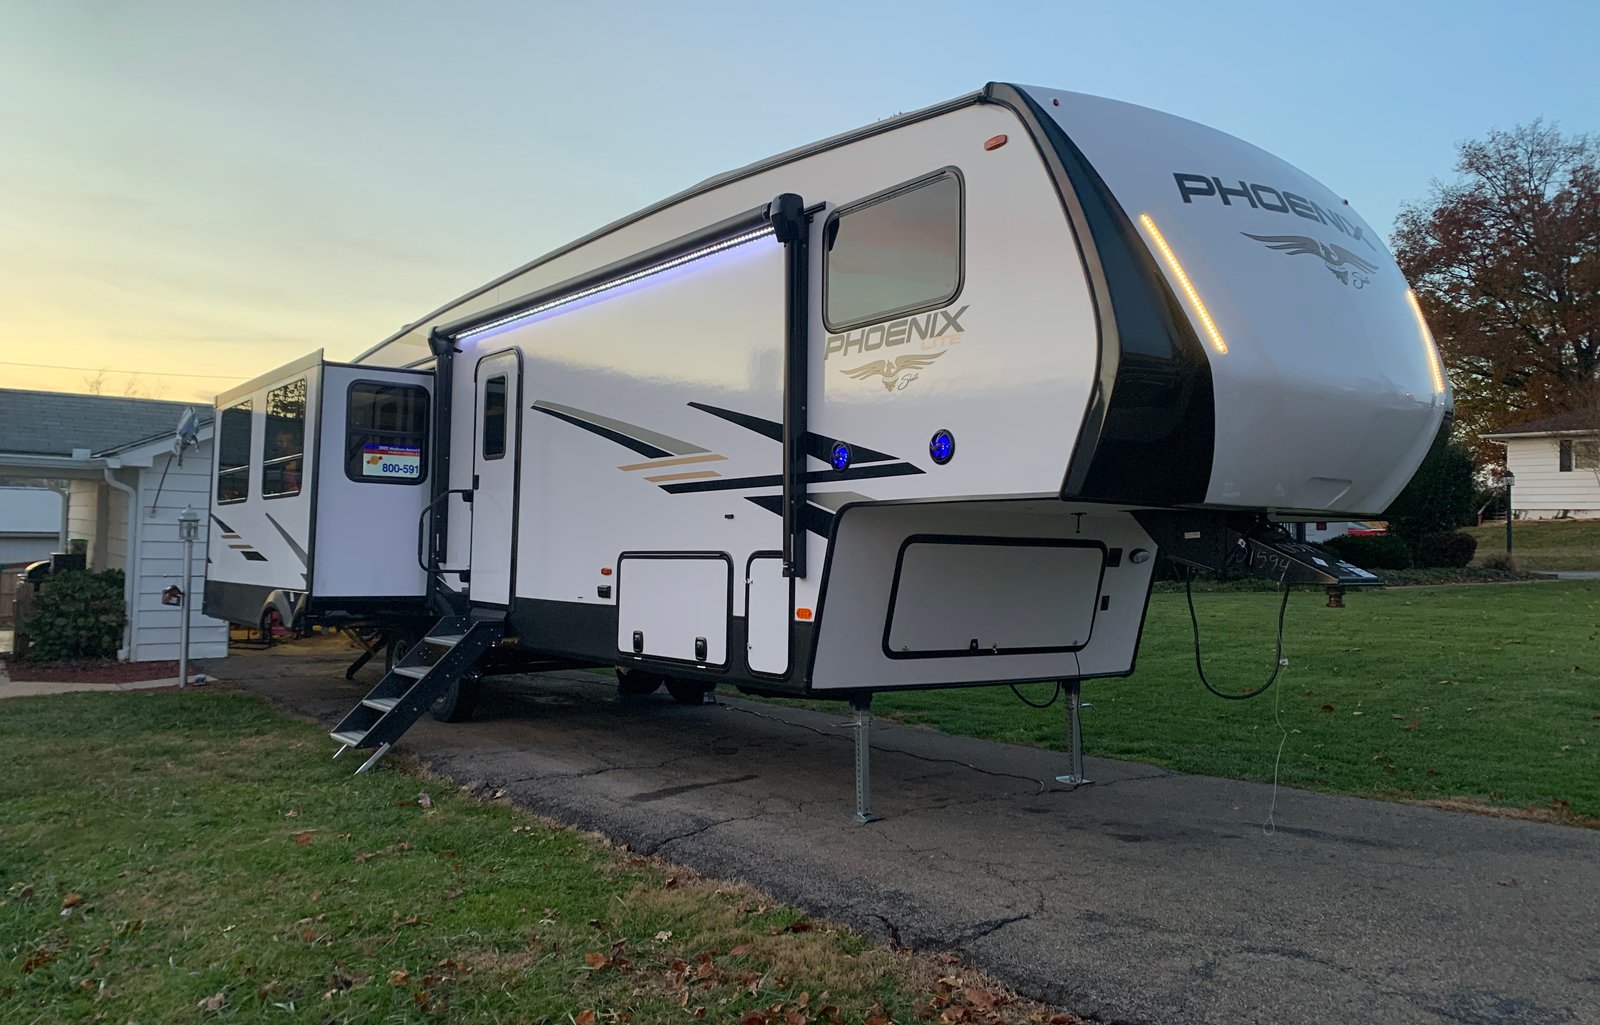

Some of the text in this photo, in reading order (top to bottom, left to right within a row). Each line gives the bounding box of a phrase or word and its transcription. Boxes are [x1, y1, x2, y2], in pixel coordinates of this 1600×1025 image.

[1173, 172, 1379, 252] PHOENIX
[824, 305, 970, 360] PHOENIX
[382, 463, 419, 474] 800-591
